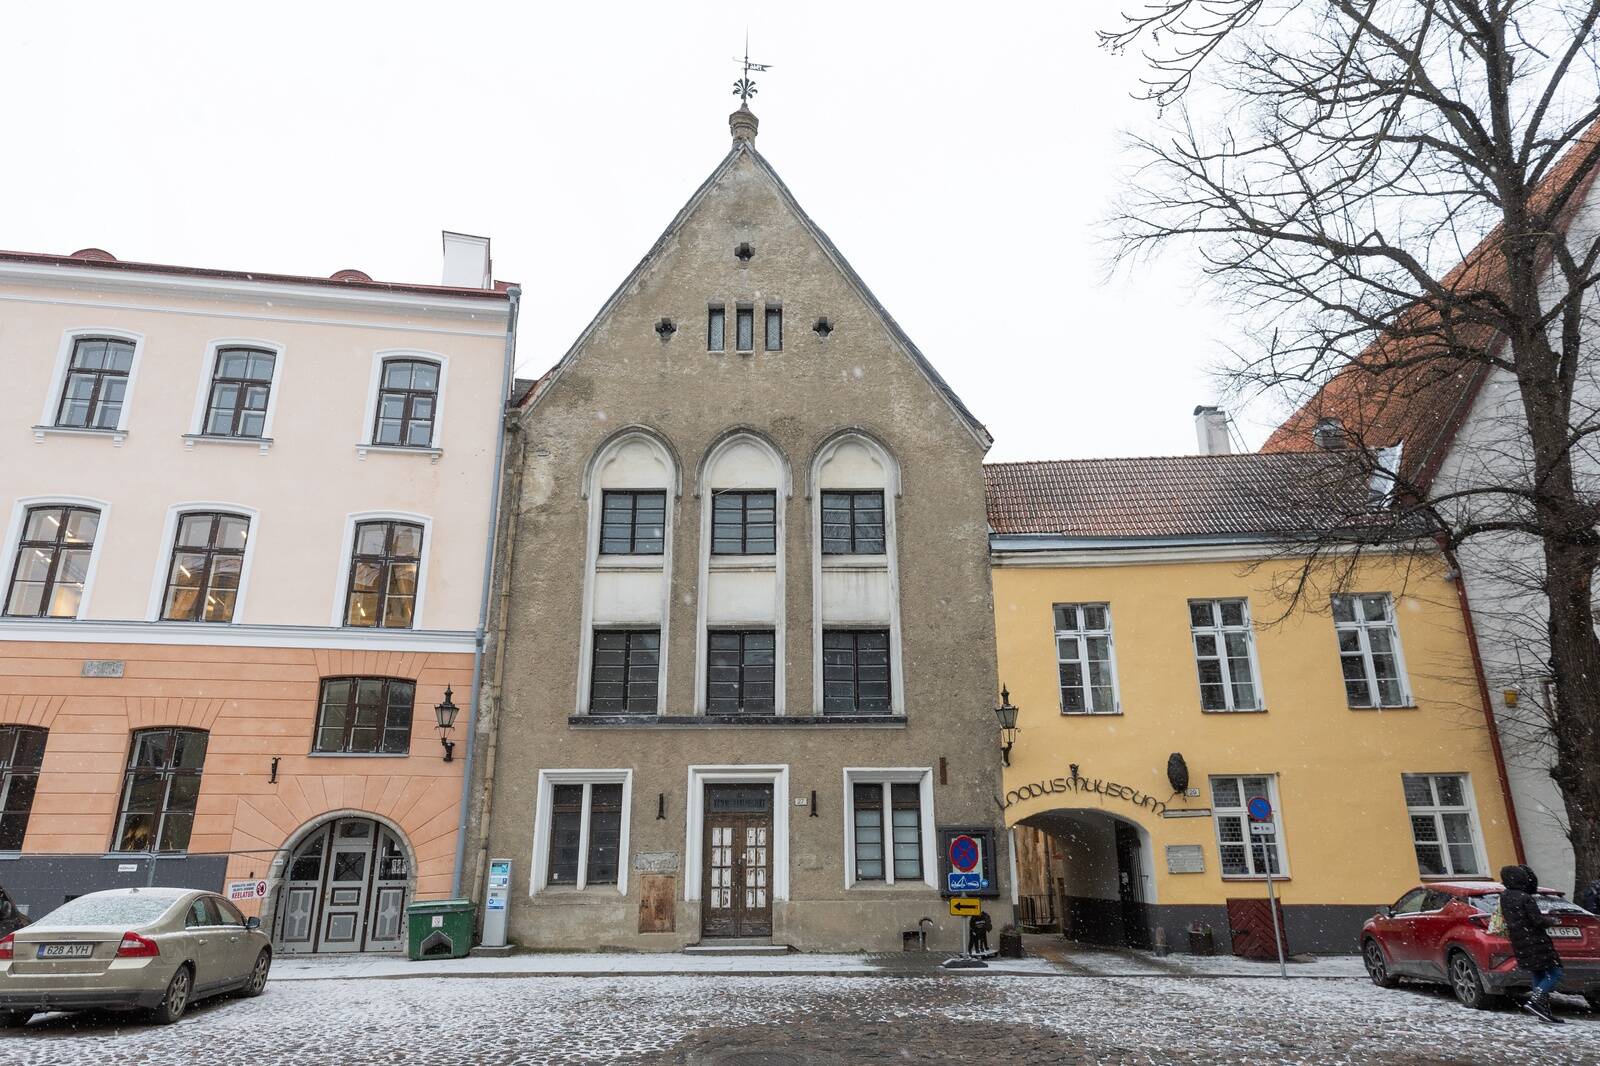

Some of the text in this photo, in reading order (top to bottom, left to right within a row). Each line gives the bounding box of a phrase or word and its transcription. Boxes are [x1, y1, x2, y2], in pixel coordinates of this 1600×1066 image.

[994, 777, 1166, 816] LOODUSMUUSEUM
[46, 945, 89, 955] 628 AYH
